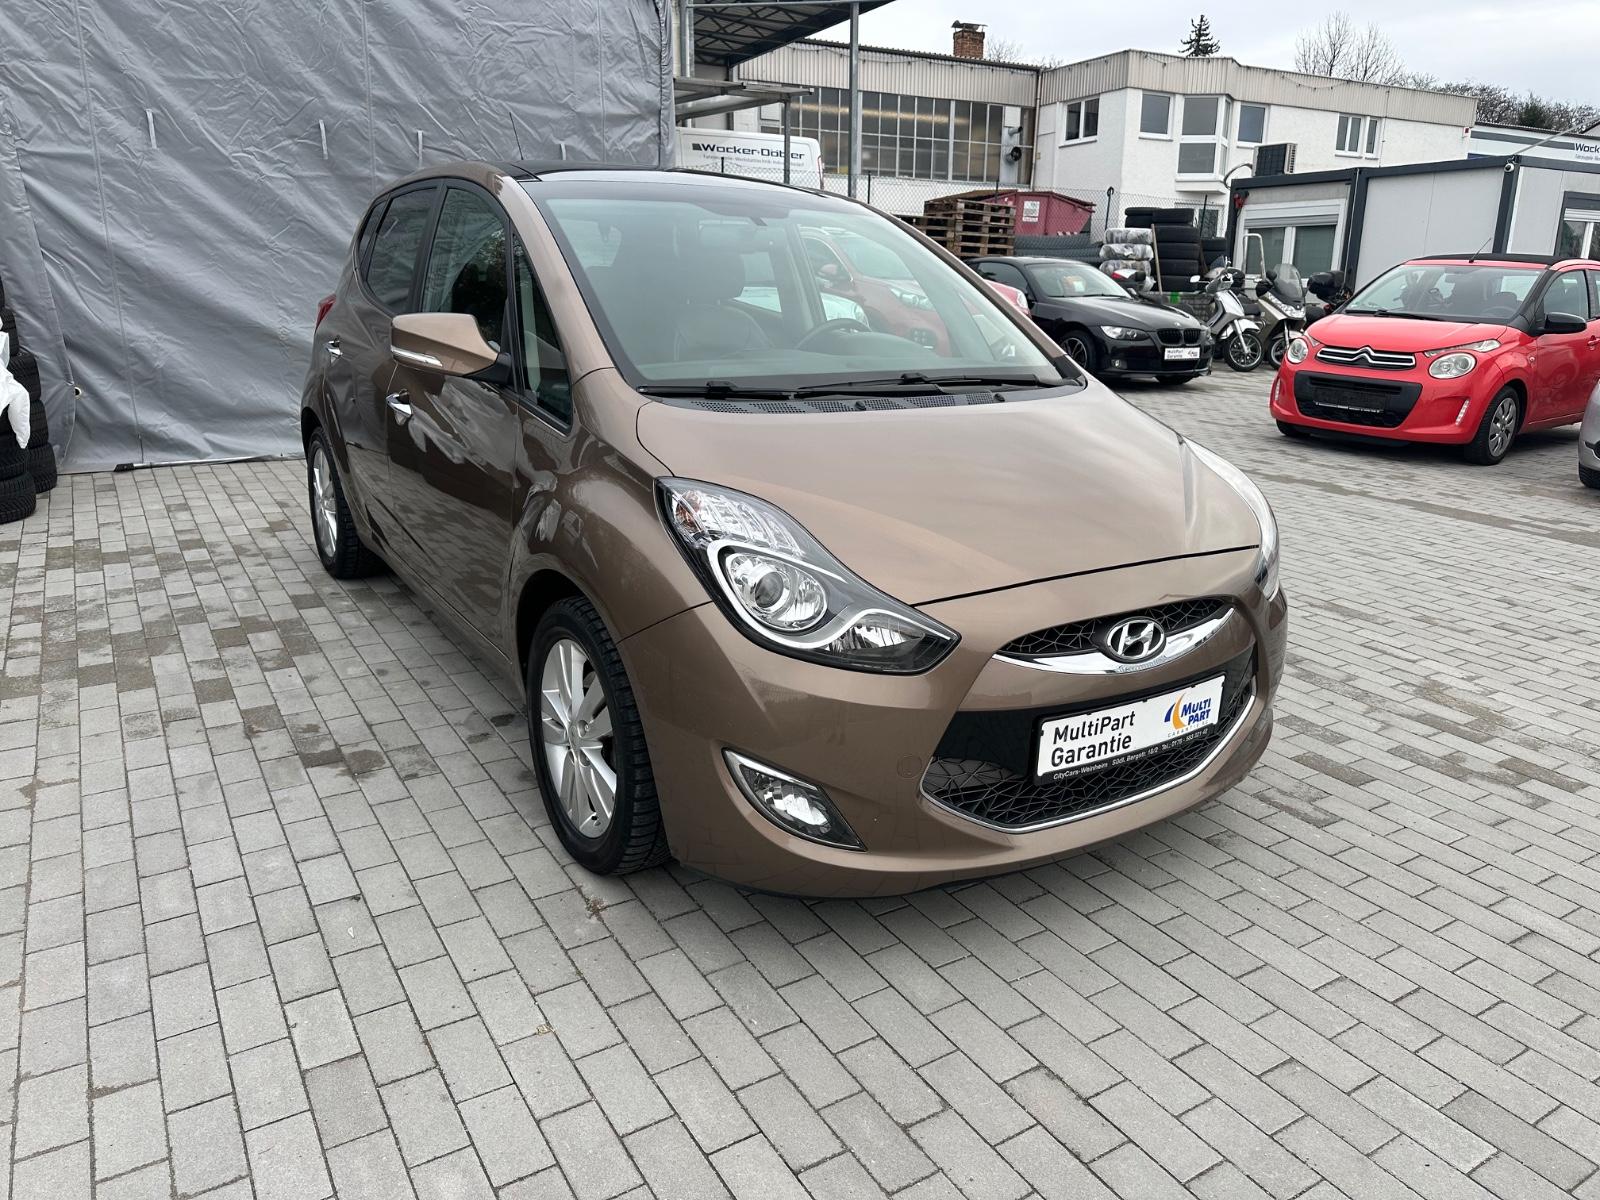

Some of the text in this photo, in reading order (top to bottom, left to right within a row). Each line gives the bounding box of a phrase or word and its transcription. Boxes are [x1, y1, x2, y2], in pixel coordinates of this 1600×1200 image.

[1052, 711, 1136, 745] MultiPart
[1187, 709, 1211, 725] PART
[1051, 734, 1132, 767] Garantie
